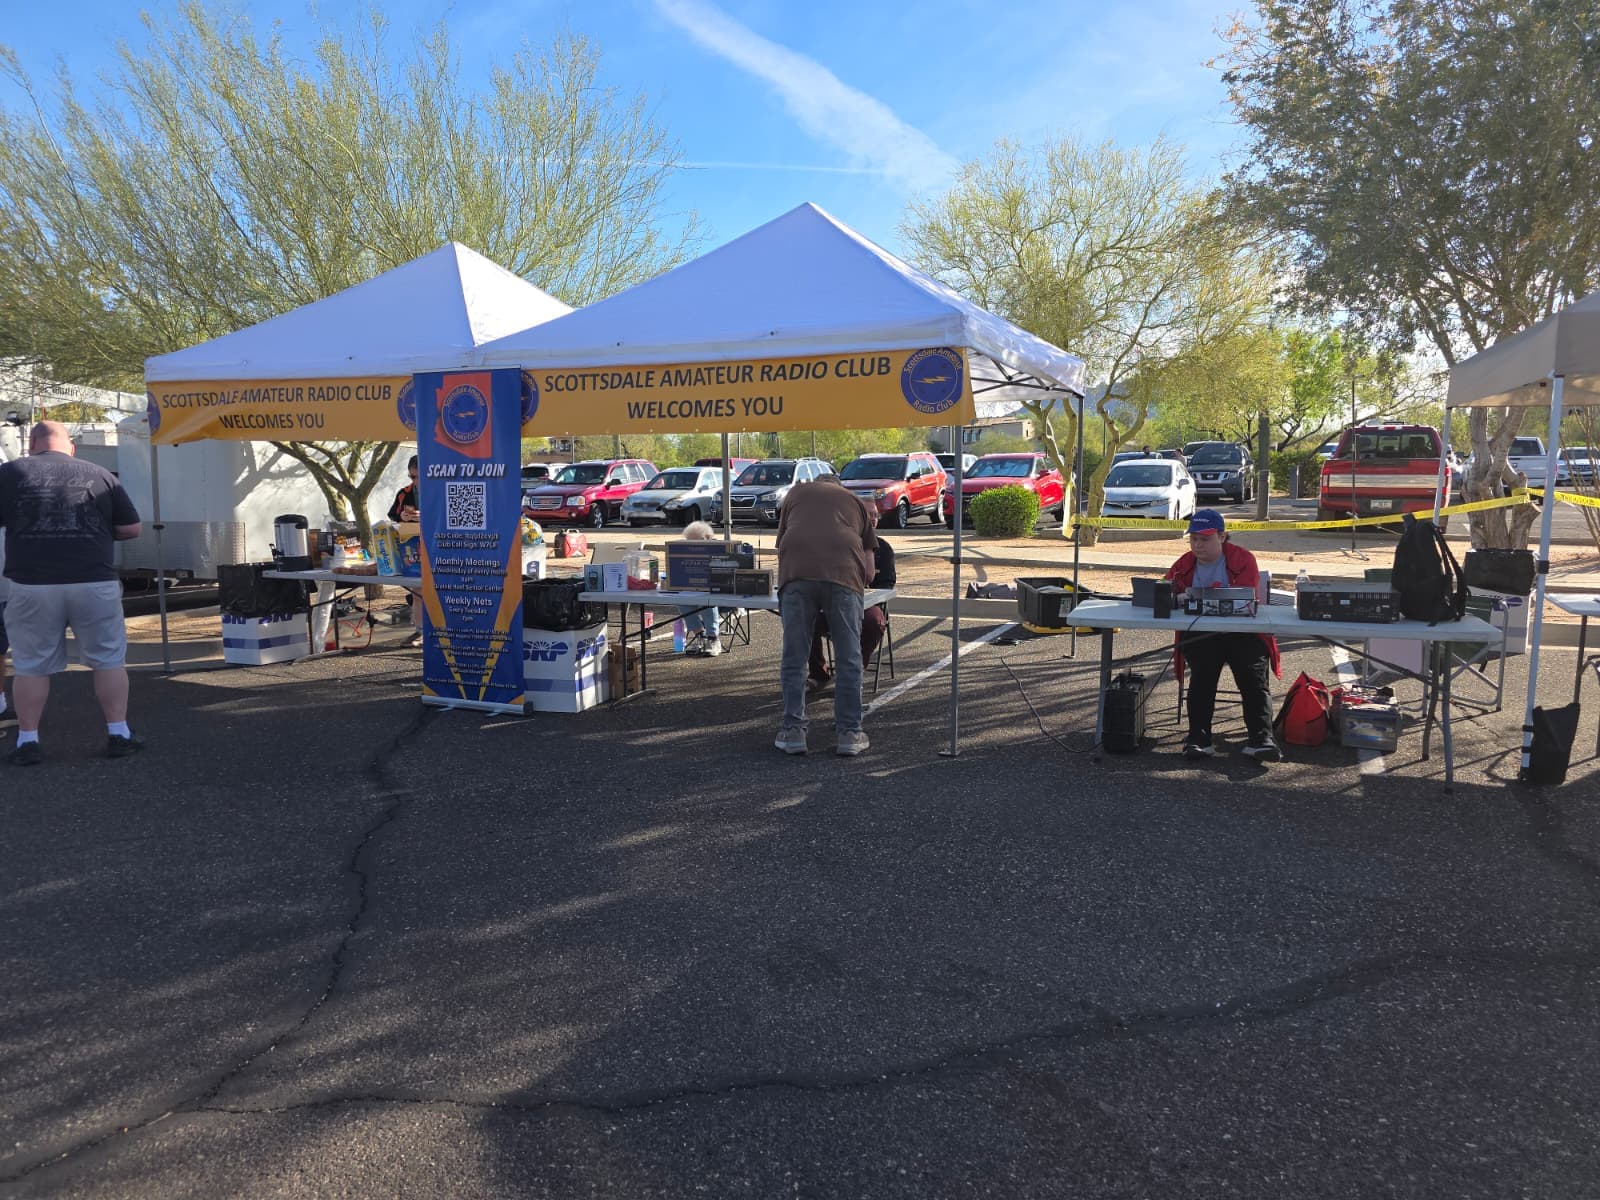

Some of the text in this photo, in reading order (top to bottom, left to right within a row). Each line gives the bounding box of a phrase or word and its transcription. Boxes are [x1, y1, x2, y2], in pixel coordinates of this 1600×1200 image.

[544, 370, 655, 393] SCOTTSDALE
[659, 364, 754, 388] AMATEUR
[760, 360, 828, 382] RADIO
[834, 356, 891, 378] CLUB
[162, 391, 238, 409] SCOTTSDALE
[239, 387, 305, 404] AMATEUR
[308, 384, 351, 402] RADIO
[355, 384, 392, 401] CLUB
[627, 396, 783, 420] WELCOMES YOU
[914, 399, 954, 413] Radio Club
[218, 413, 325, 429] WELCOMES YOU
[426, 463, 505, 478] SCAN TO JOIN
[435, 556, 501, 568] Monthly Meetings
[444, 595, 493, 607] Weekly Nets
